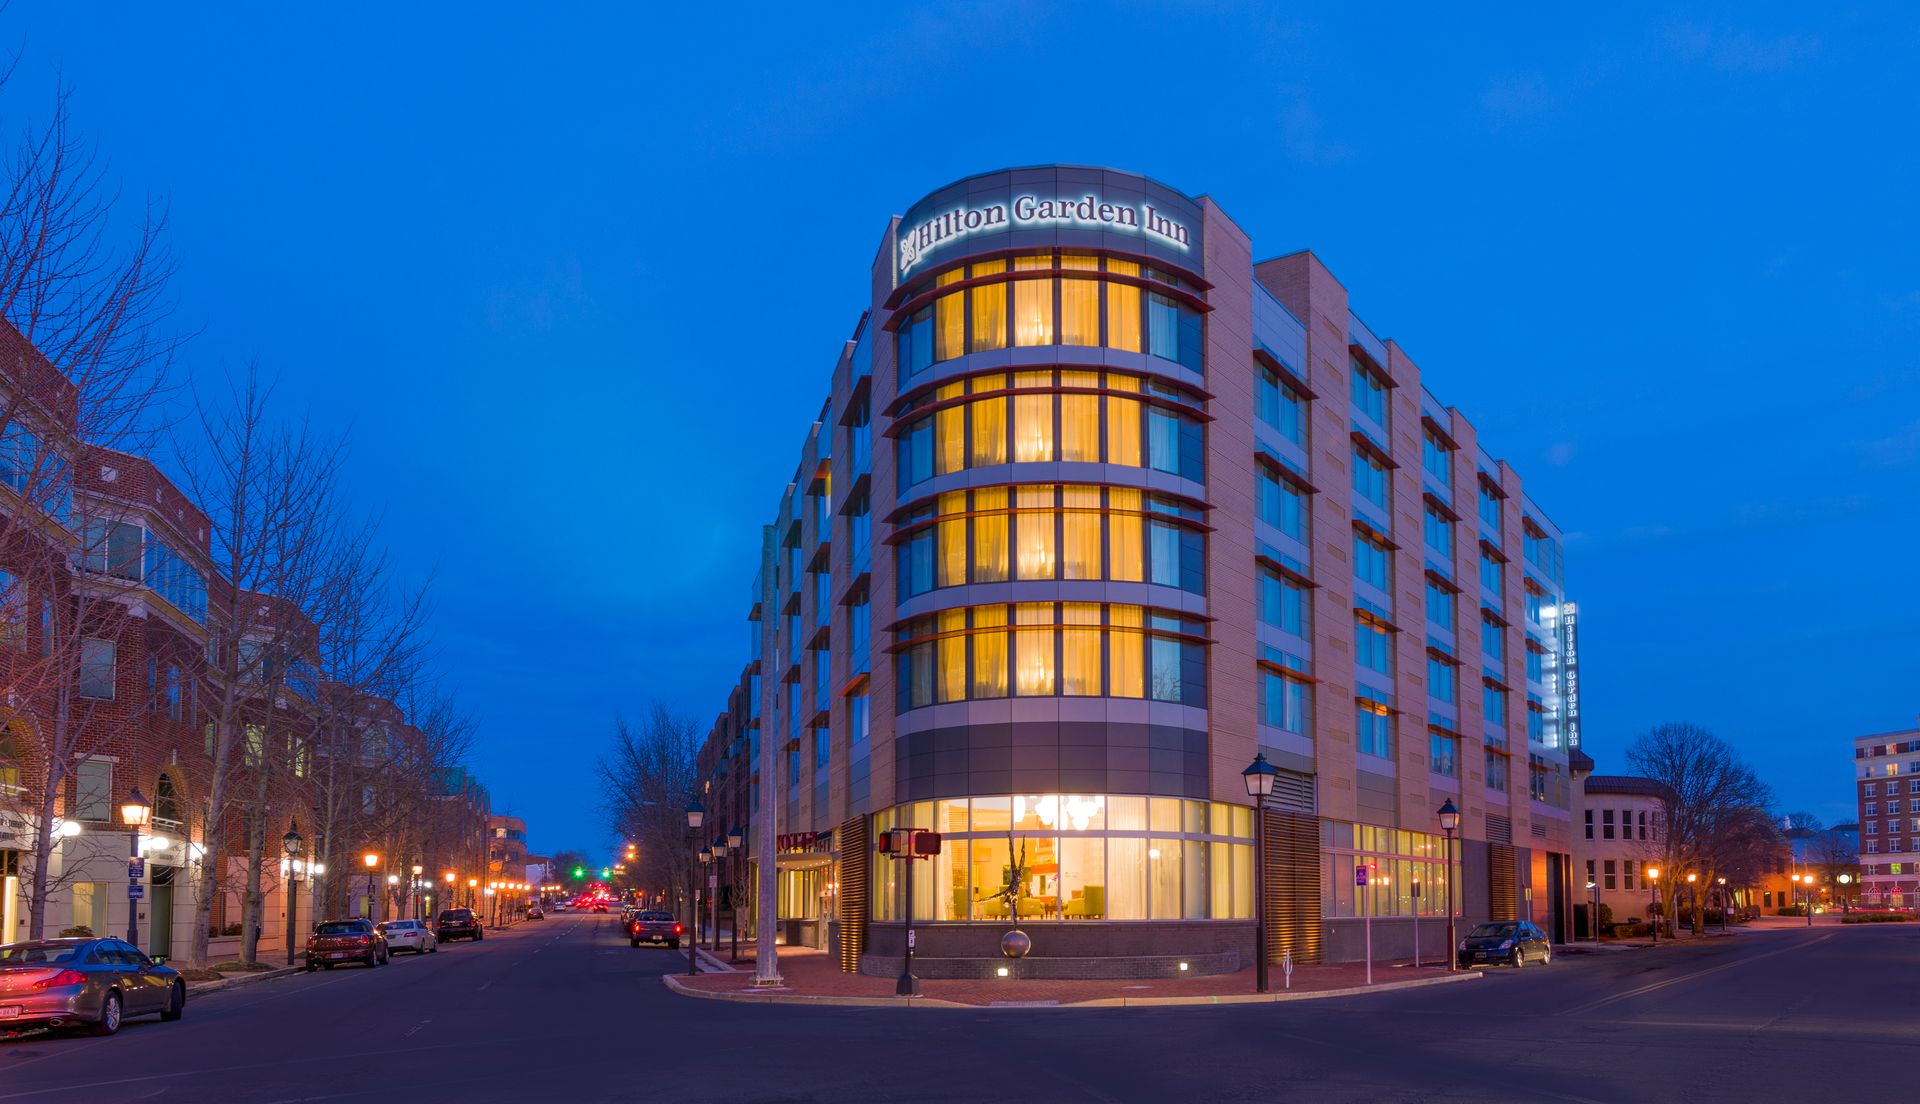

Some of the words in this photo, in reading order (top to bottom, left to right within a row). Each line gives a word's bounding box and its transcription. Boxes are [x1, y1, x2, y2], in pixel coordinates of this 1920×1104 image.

[917, 204, 1006, 251] Hilton
[1014, 195, 1137, 228] Garden
[1145, 205, 1190, 247] Inn
[1564, 615, 1576, 665] Hilton
[1566, 671, 1577, 717] Garden
[1569, 722, 1578, 746] Inn
